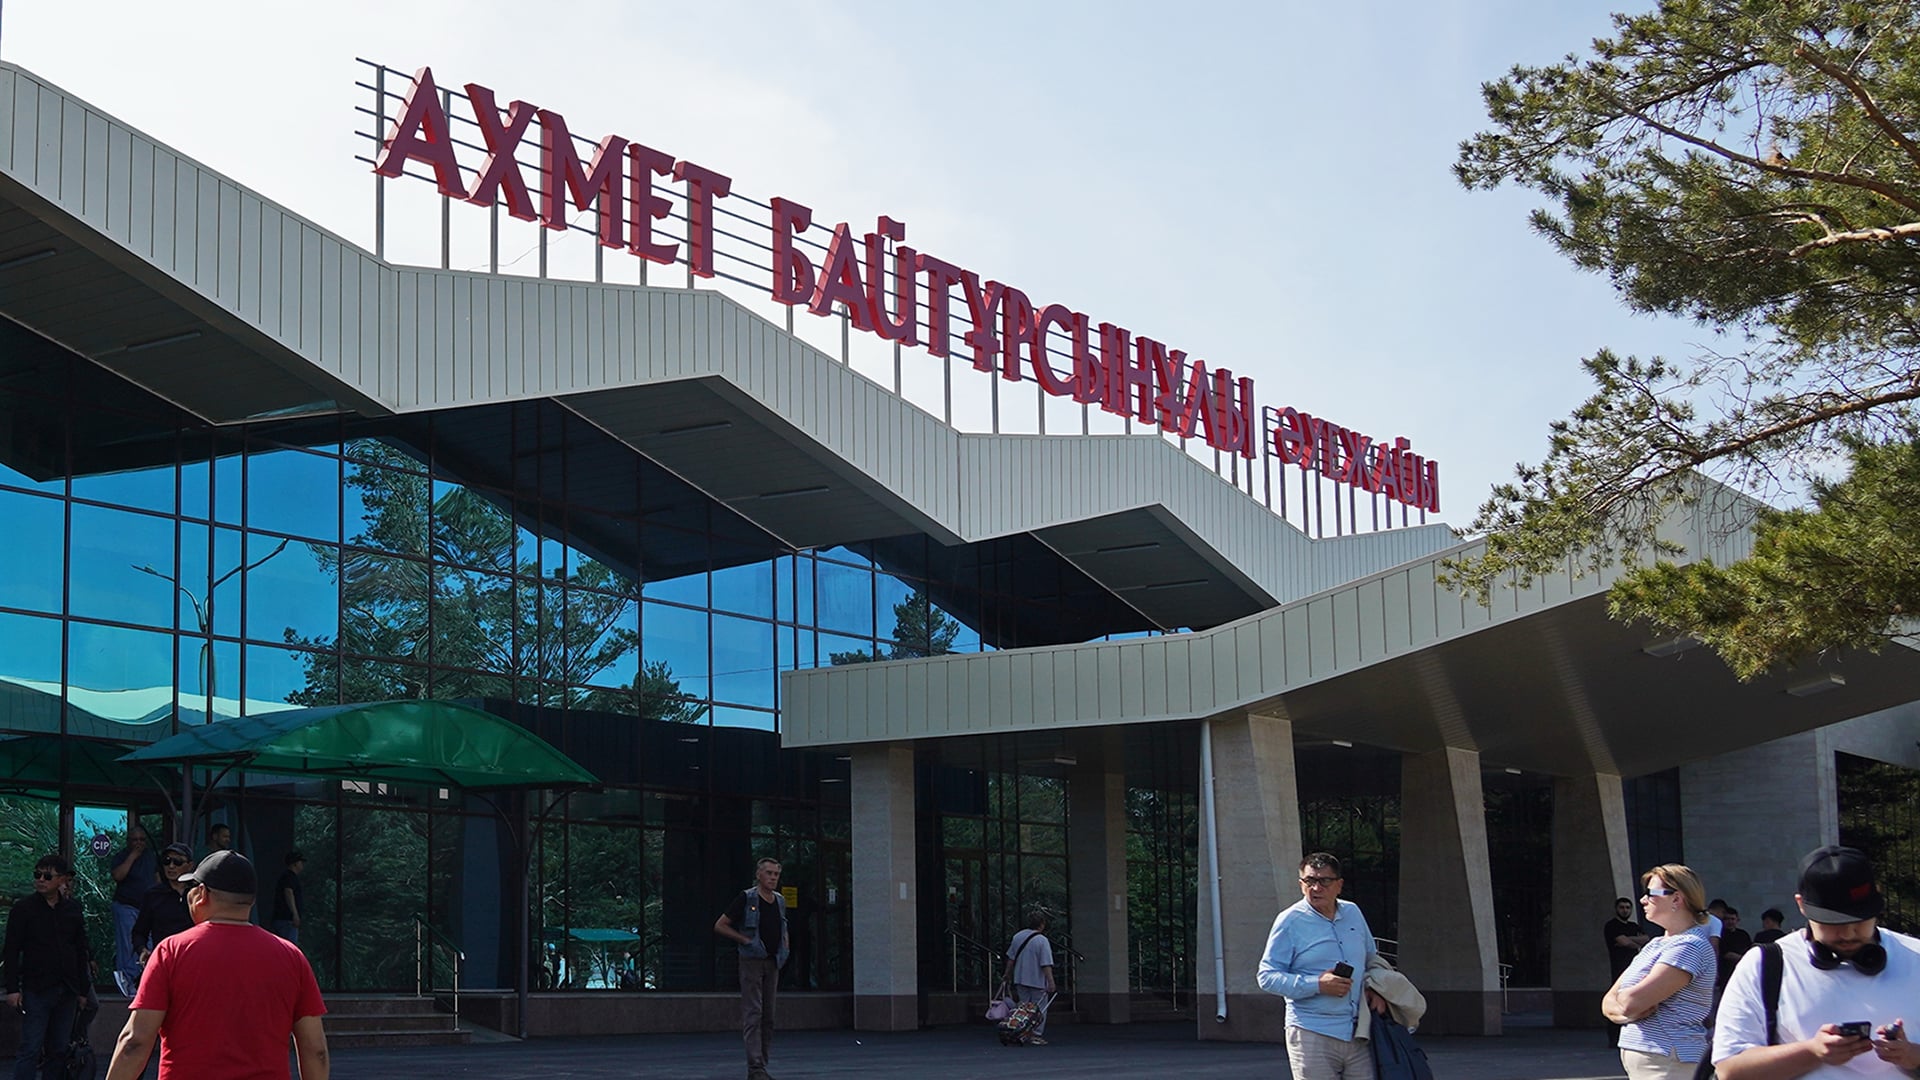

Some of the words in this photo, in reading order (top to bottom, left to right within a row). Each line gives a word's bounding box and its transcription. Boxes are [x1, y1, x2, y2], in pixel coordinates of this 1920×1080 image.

[371, 66, 731, 278] АХМЕТ
[770, 197, 1256, 459] БАЙТҰРСЫНҰЛЫ
[93, 840, 110, 850] CIP
